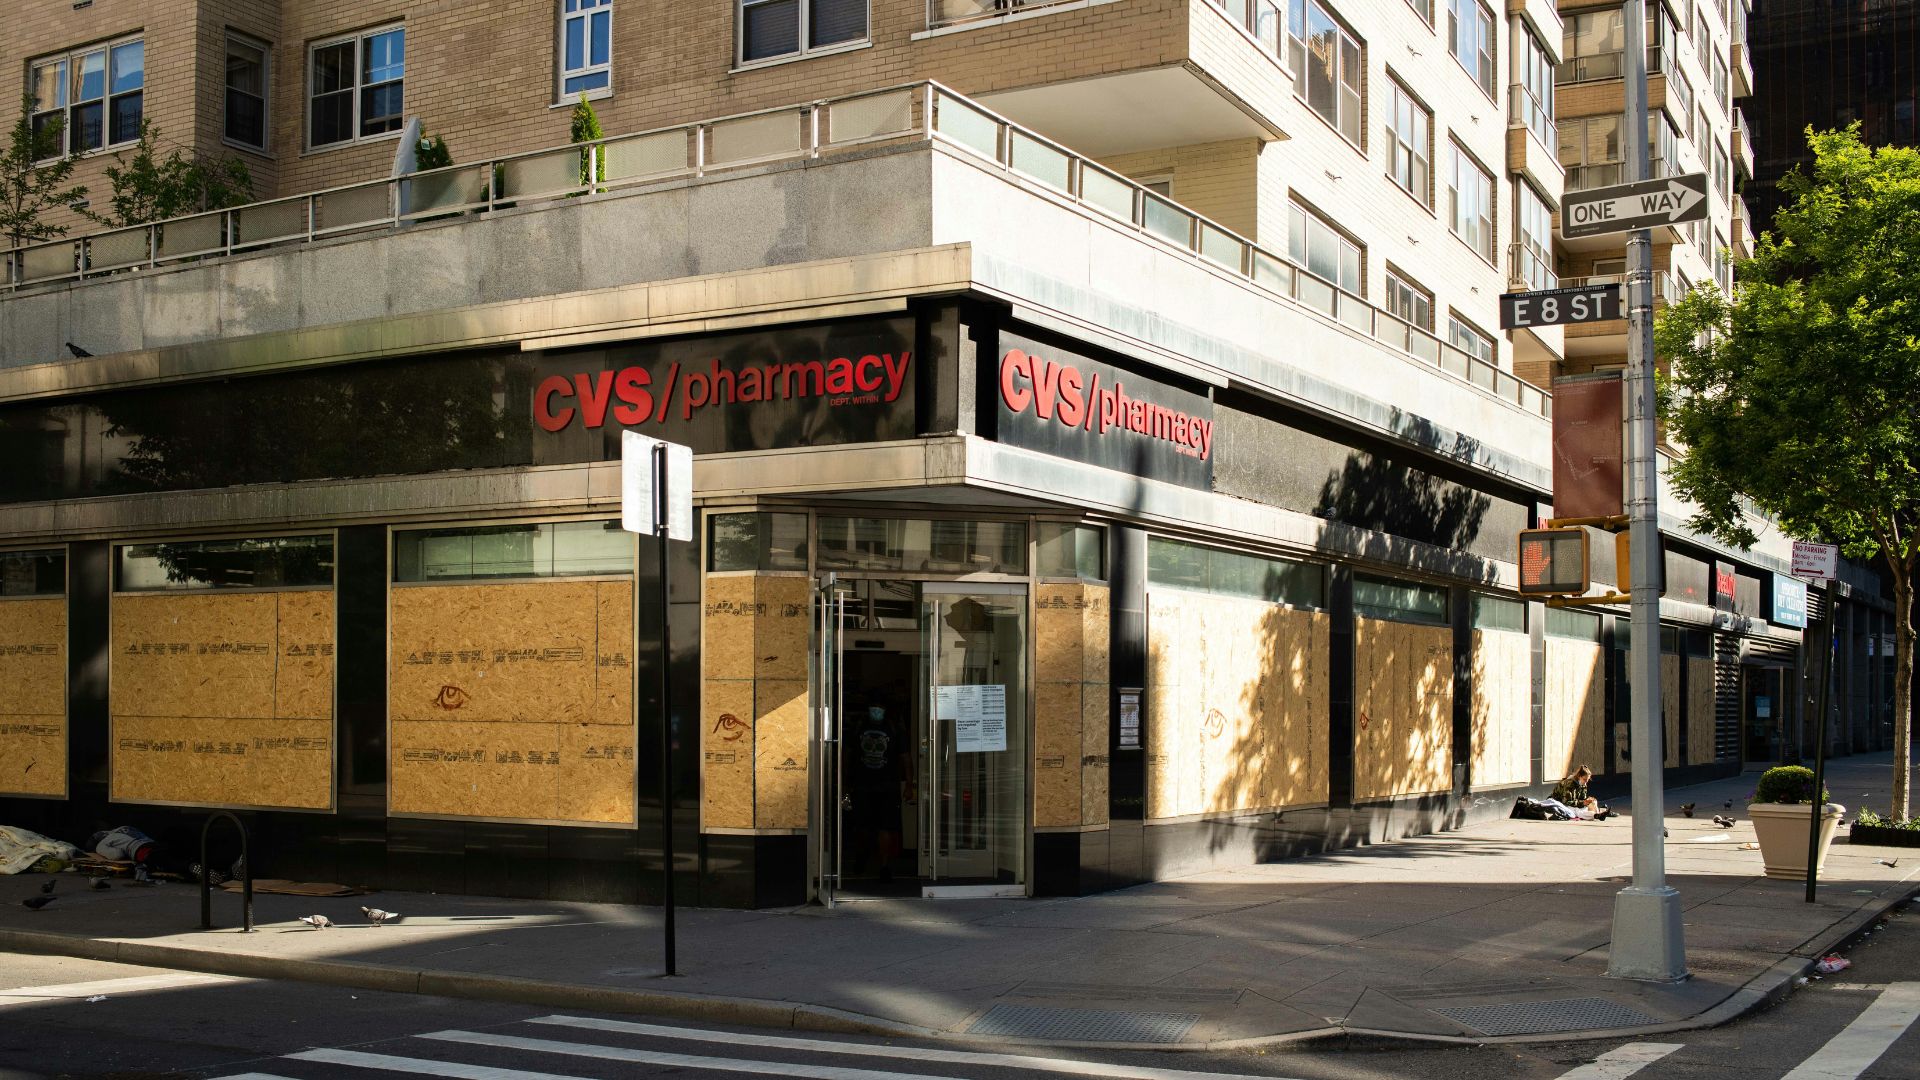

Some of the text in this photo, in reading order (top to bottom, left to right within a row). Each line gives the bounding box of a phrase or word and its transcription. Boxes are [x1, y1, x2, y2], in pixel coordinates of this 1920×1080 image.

[1574, 190, 1687, 224] ONE WAY
[1514, 292, 1607, 326] E 8 ST
[533, 351, 912, 433] CVS/pharmacy
[852, 395, 879, 405] WITHIN
[1000, 348, 1214, 460] CVS/pharmacy
[1804, 546, 1827, 555] PARKING
